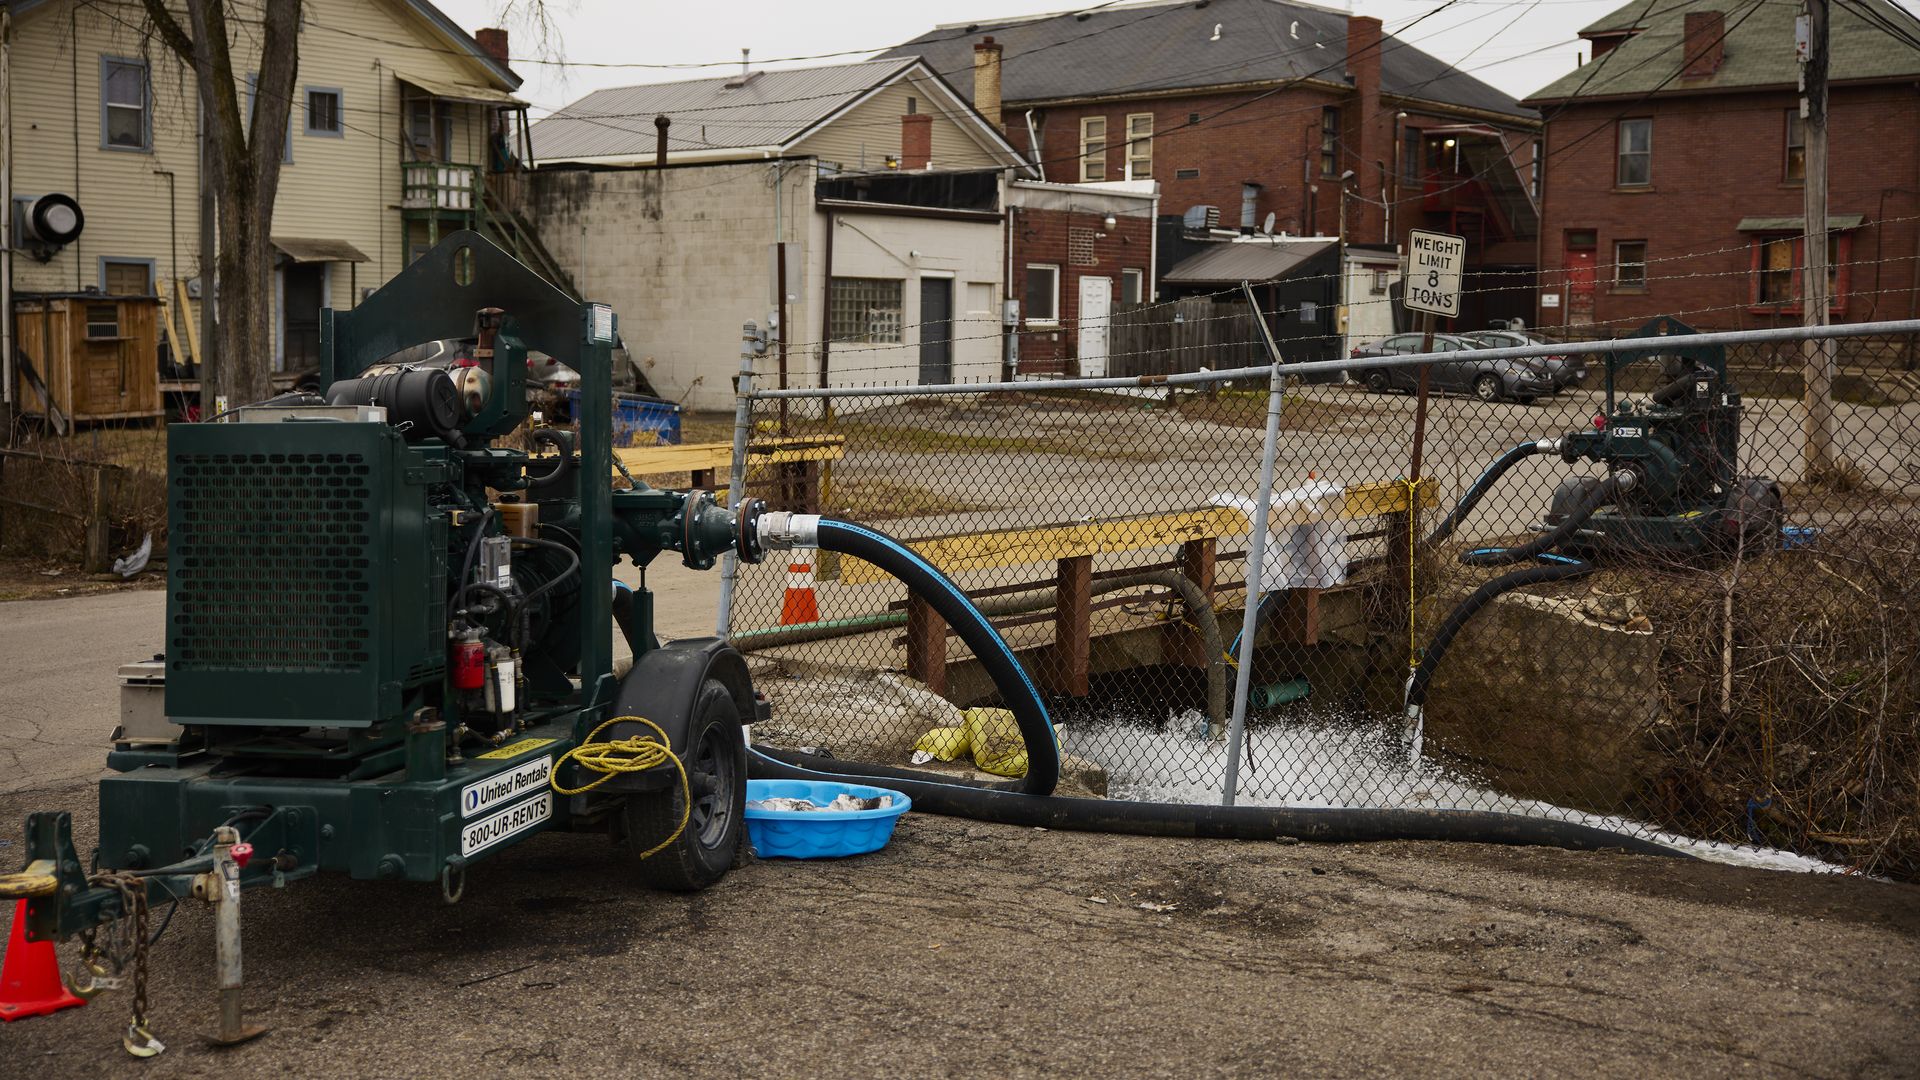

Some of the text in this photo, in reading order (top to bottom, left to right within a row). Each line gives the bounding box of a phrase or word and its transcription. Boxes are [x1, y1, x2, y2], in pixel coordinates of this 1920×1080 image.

[1414, 236, 1461, 255] WEIGHT
[1419, 253, 1452, 269] LIMIT
[1428, 270, 1439, 287] 8
[1412, 287, 1452, 308] TONS
[480, 763, 548, 805] United Rentals
[469, 798, 547, 848] 800-UR-RENTS
